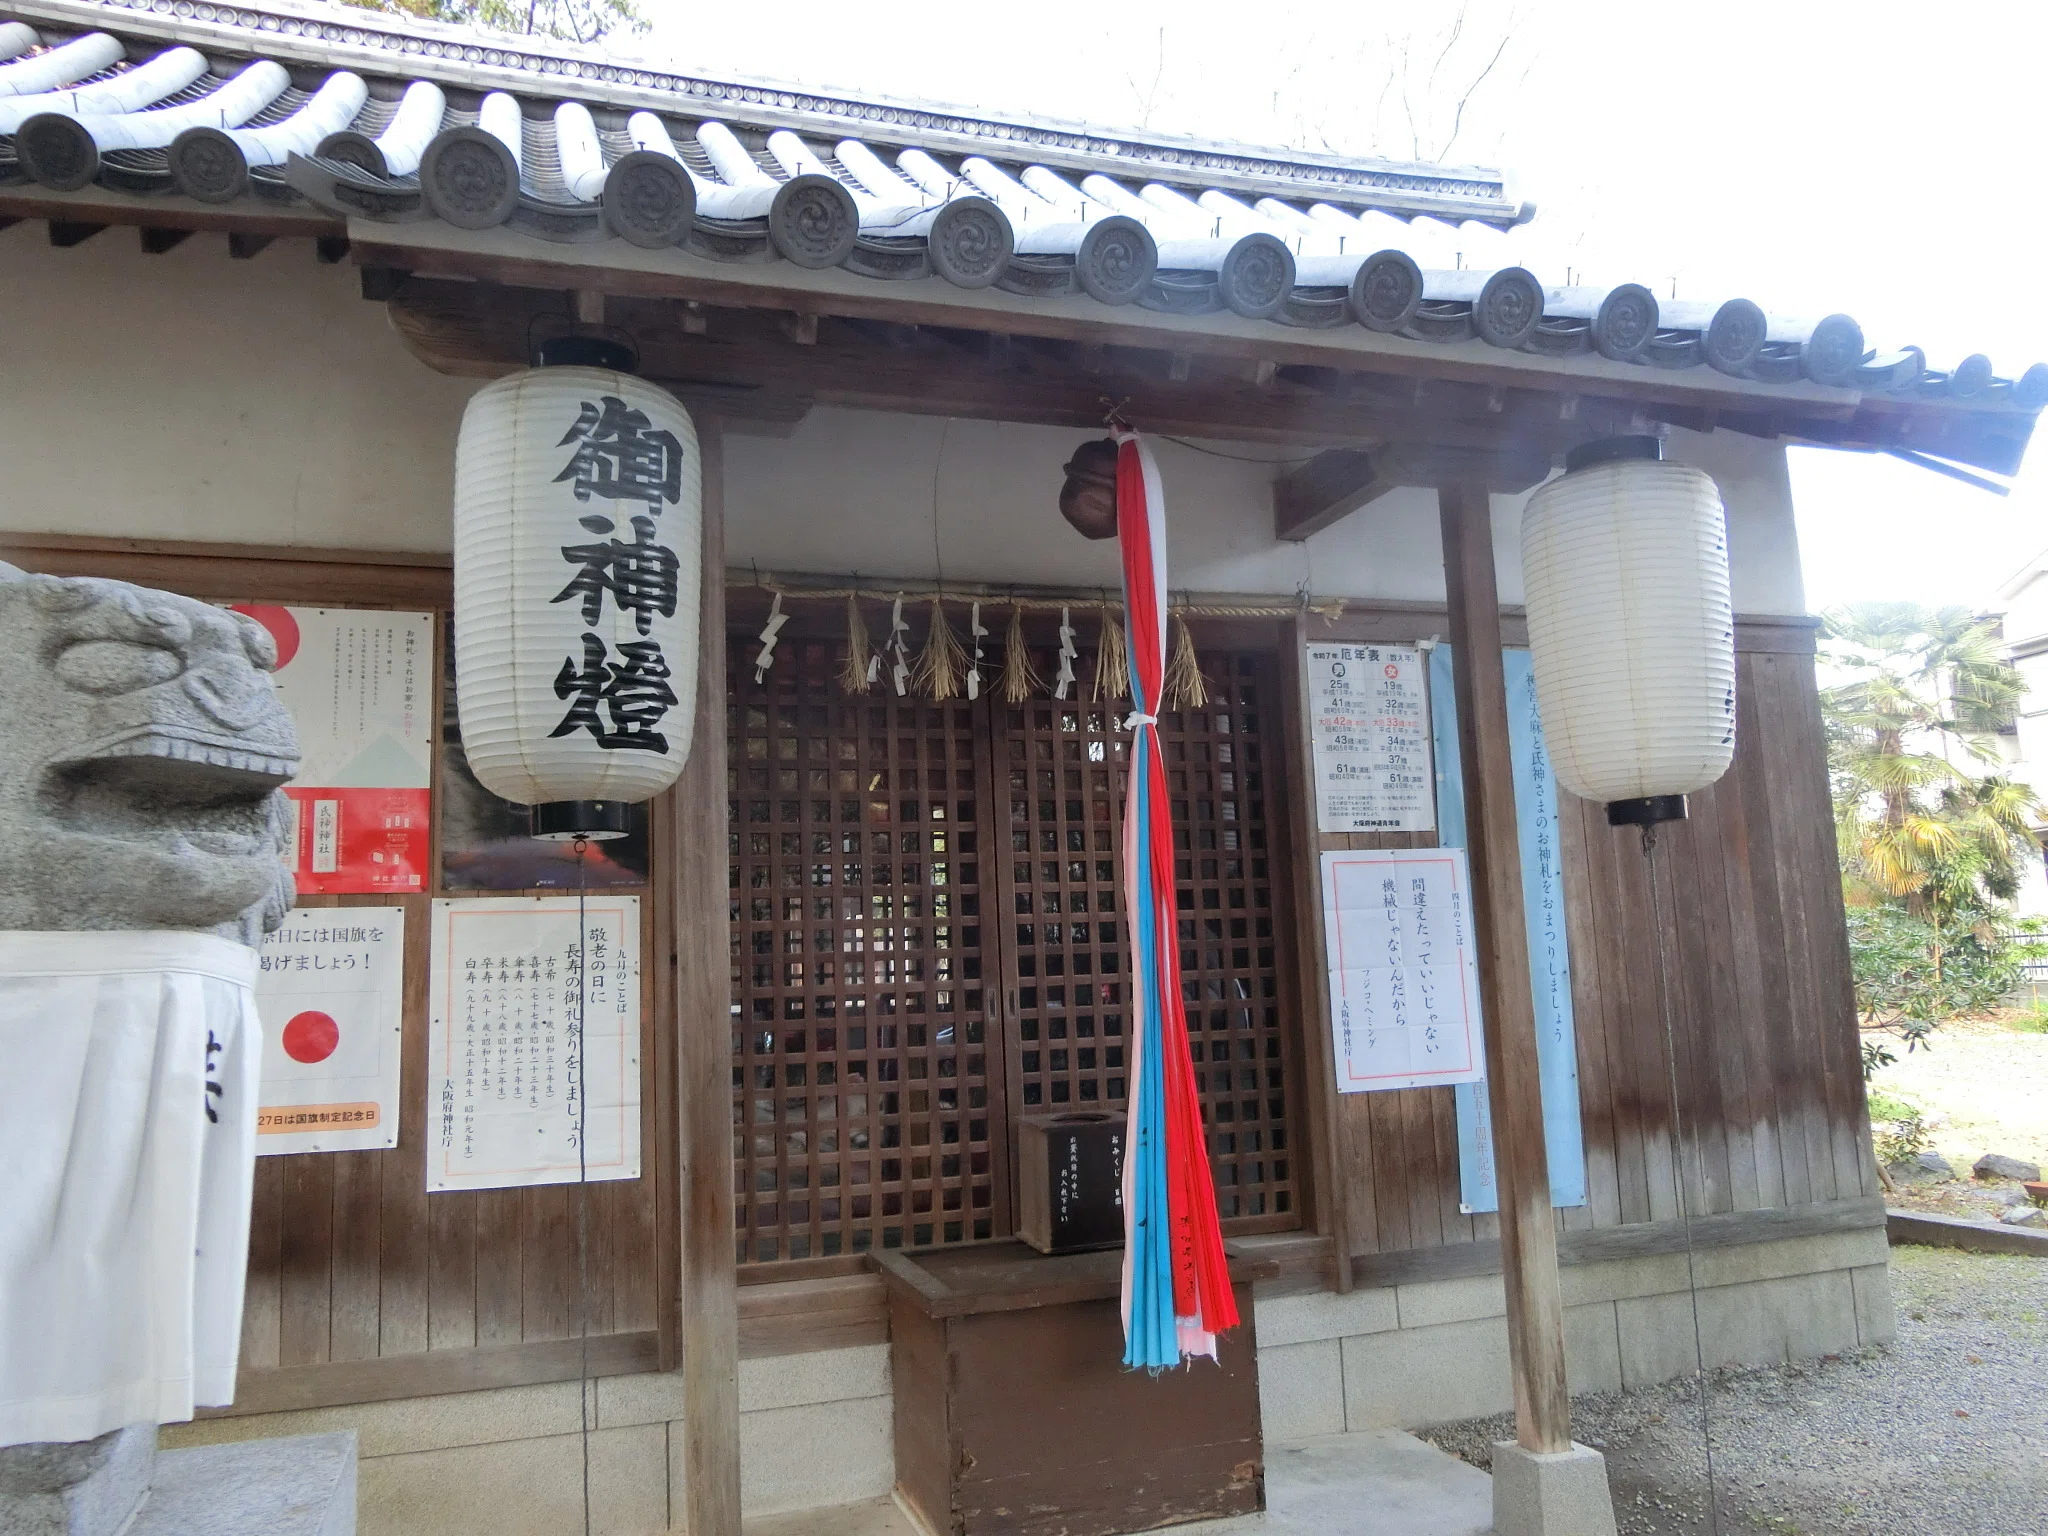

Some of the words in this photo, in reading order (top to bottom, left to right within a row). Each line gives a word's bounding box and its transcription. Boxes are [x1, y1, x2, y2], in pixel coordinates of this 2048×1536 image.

[548, 396, 685, 756] 御神燈
[405, 630, 415, 656] お神札
[1341, 647, 1380, 662] 厄年表
[318, 805, 332, 854] 氏神神社
[1451, 892, 1464, 947] 四月のことば
[589, 927, 608, 1005] 敬老の日に
[617, 949, 628, 1015] 九月のことば
[1381, 877, 1407, 1027] 機械じゃないんだから
[1411, 877, 1440, 1054] 間違えたっていいじゃない
[564, 943, 583, 1149] 長寿の御礼参りをしましょう
[1341, 998, 1353, 1057] 大阪府神社庁
[257, 1110, 376, 1127] 27日は国旗制定記念日
[441, 1079, 455, 1149] 大阪府神社庁
[1111, 1134, 1121, 1177] おみくじ
